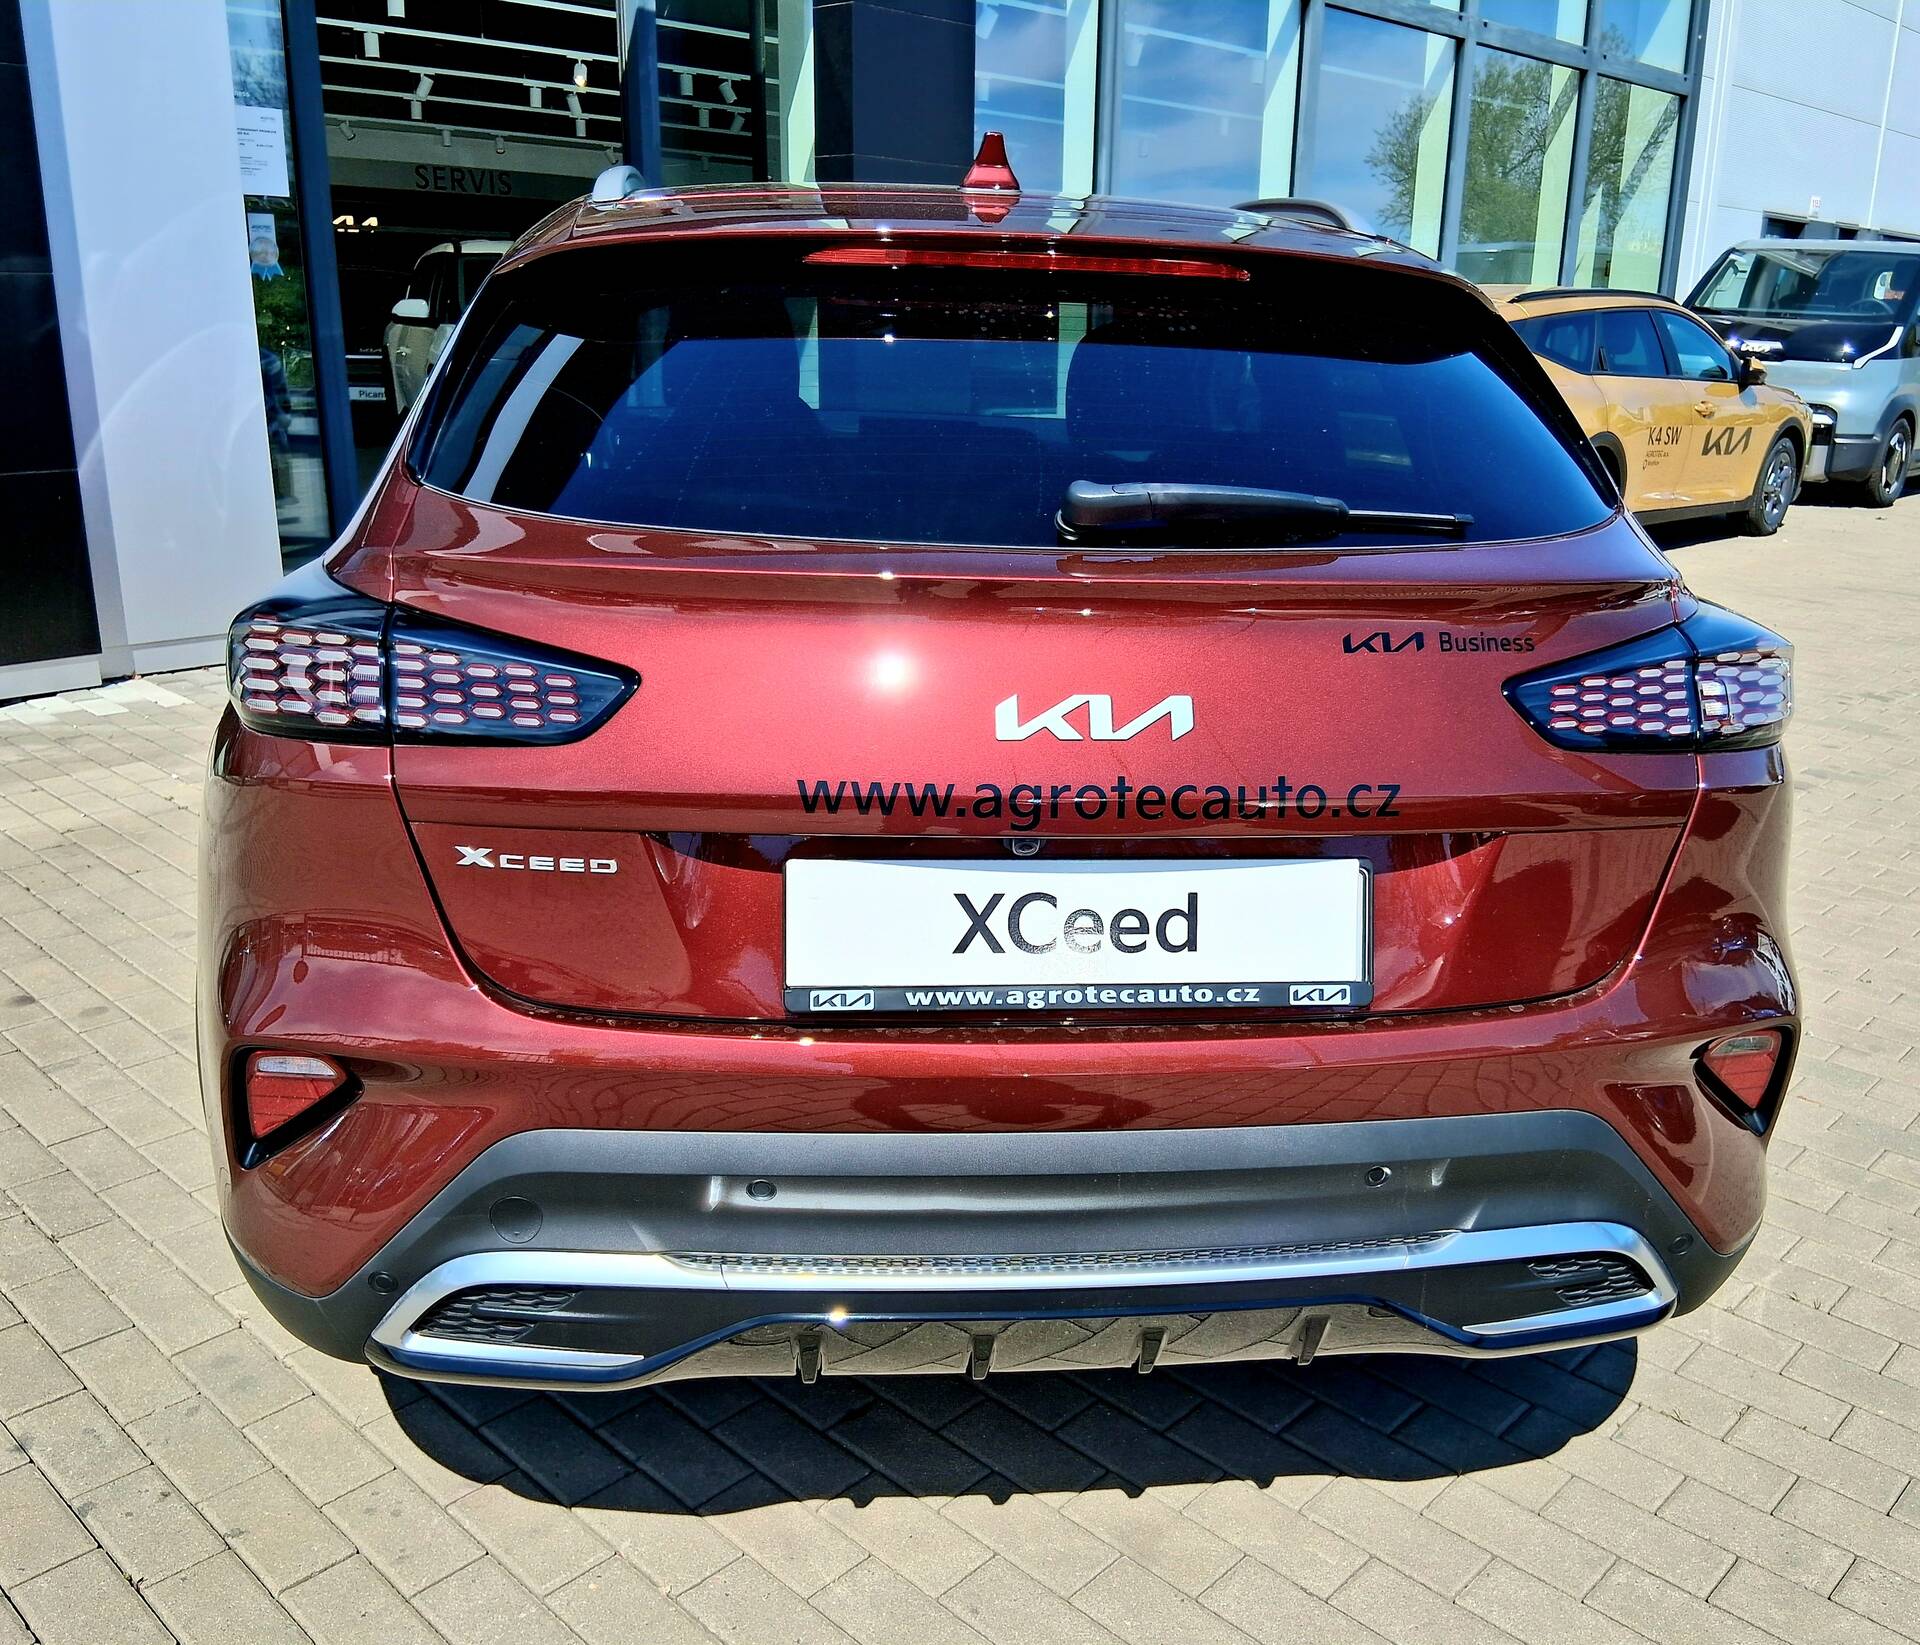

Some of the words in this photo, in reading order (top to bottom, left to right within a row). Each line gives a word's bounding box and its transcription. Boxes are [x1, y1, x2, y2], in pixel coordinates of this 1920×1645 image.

[414, 164, 513, 196] SERVIS
[1648, 426, 1663, 446] K4
[1664, 425, 1682, 446] SW
[1701, 426, 1753, 456] KIA
[1342, 631, 1425, 654] KIA
[1438, 631, 1536, 653] Business
[994, 693, 1195, 742] KIA
[797, 775, 1402, 832] www.agrotecauto.cz
[952, 891, 1200, 955] XCeed
[813, 992, 872, 1007] KIA
[905, 984, 1260, 1007] www.agrotecauto.cz
[1291, 986, 1349, 1003] KIA
